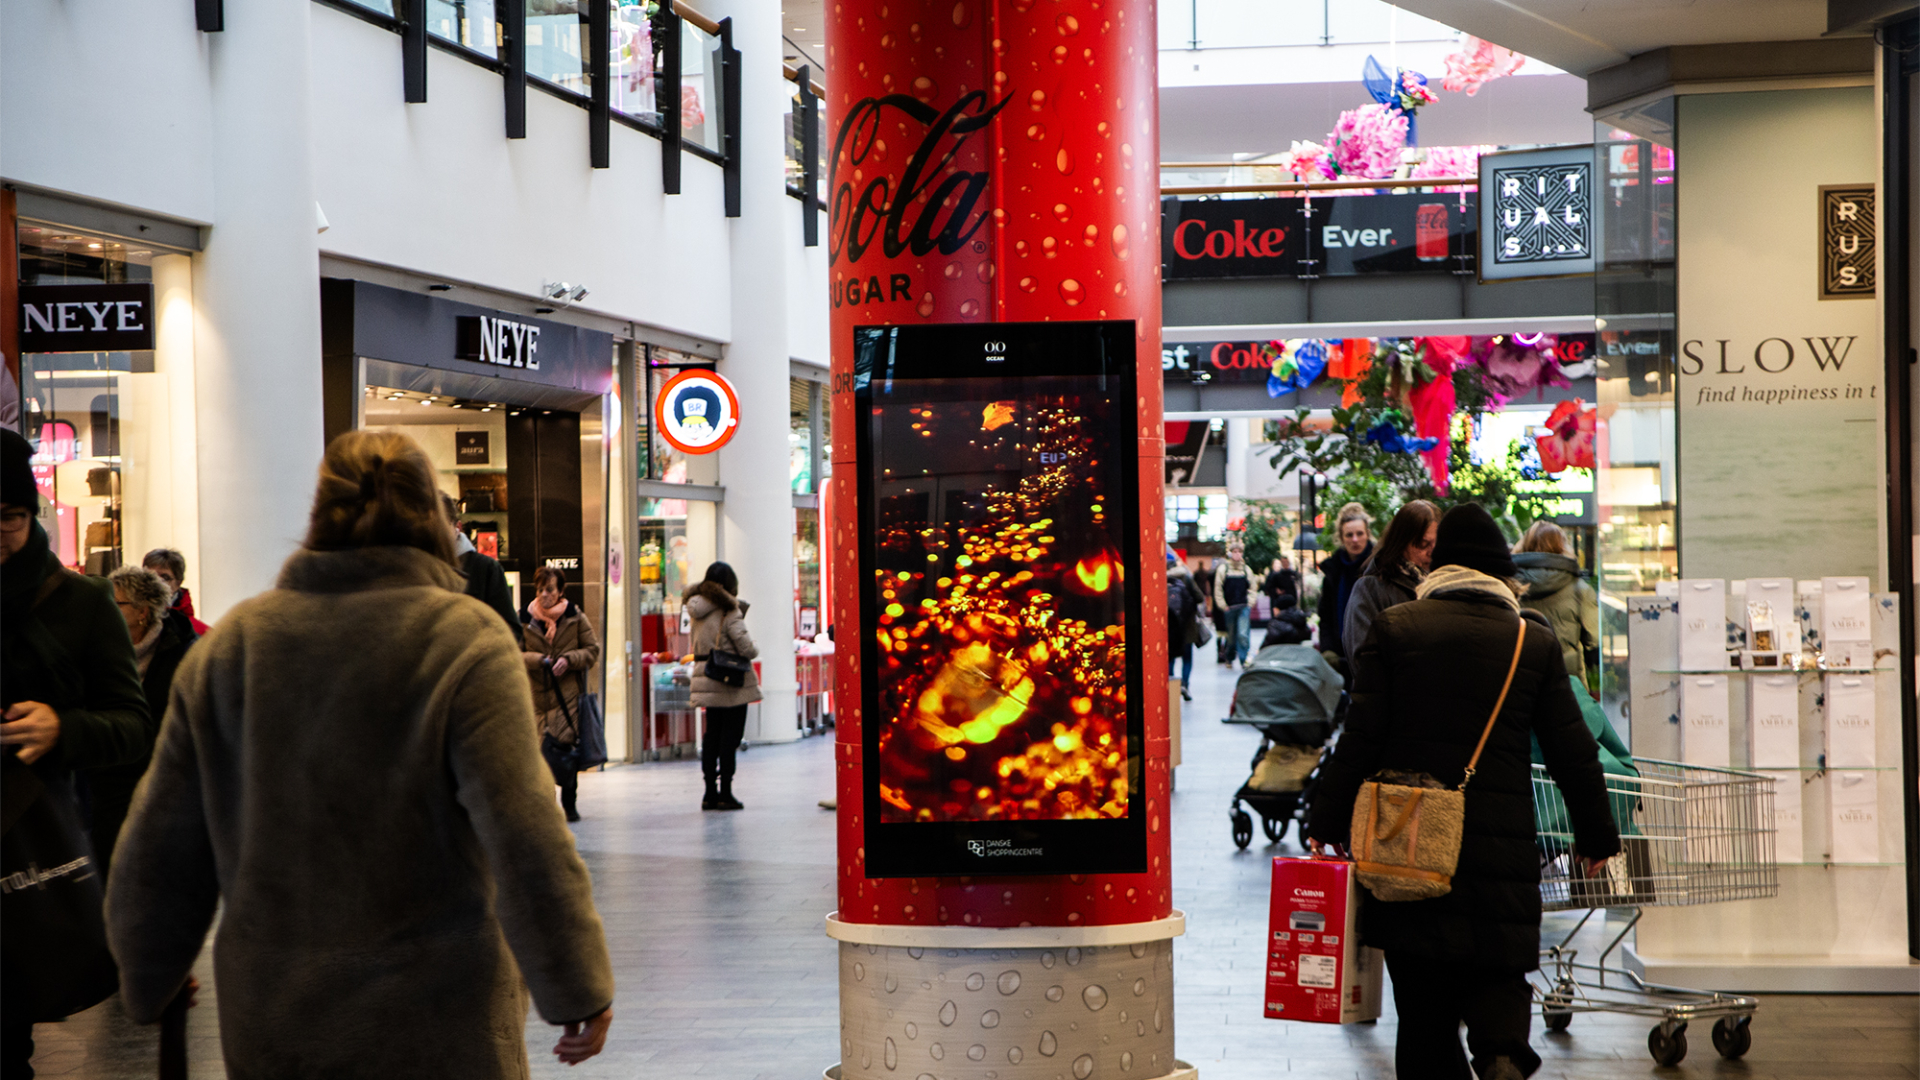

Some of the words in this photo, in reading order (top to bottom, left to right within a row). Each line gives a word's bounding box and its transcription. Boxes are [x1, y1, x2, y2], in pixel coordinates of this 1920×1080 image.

[1173, 219, 1286, 260] Coke
[23, 301, 144, 333] NEYE
[479, 315, 540, 370] NEYE
[1681, 335, 1858, 376] SLOW
[1697, 386, 1736, 406] find
[1742, 384, 1838, 405] happiness
[1845, 383, 1863, 399] in
[688, 402, 702, 412] BR
[545, 558, 579, 569] NEYE
[986, 839, 1011, 847] DANSKE
[986, 848, 1043, 857] SHOPPINGCENTRE
[1293, 888, 1325, 898] Canon
